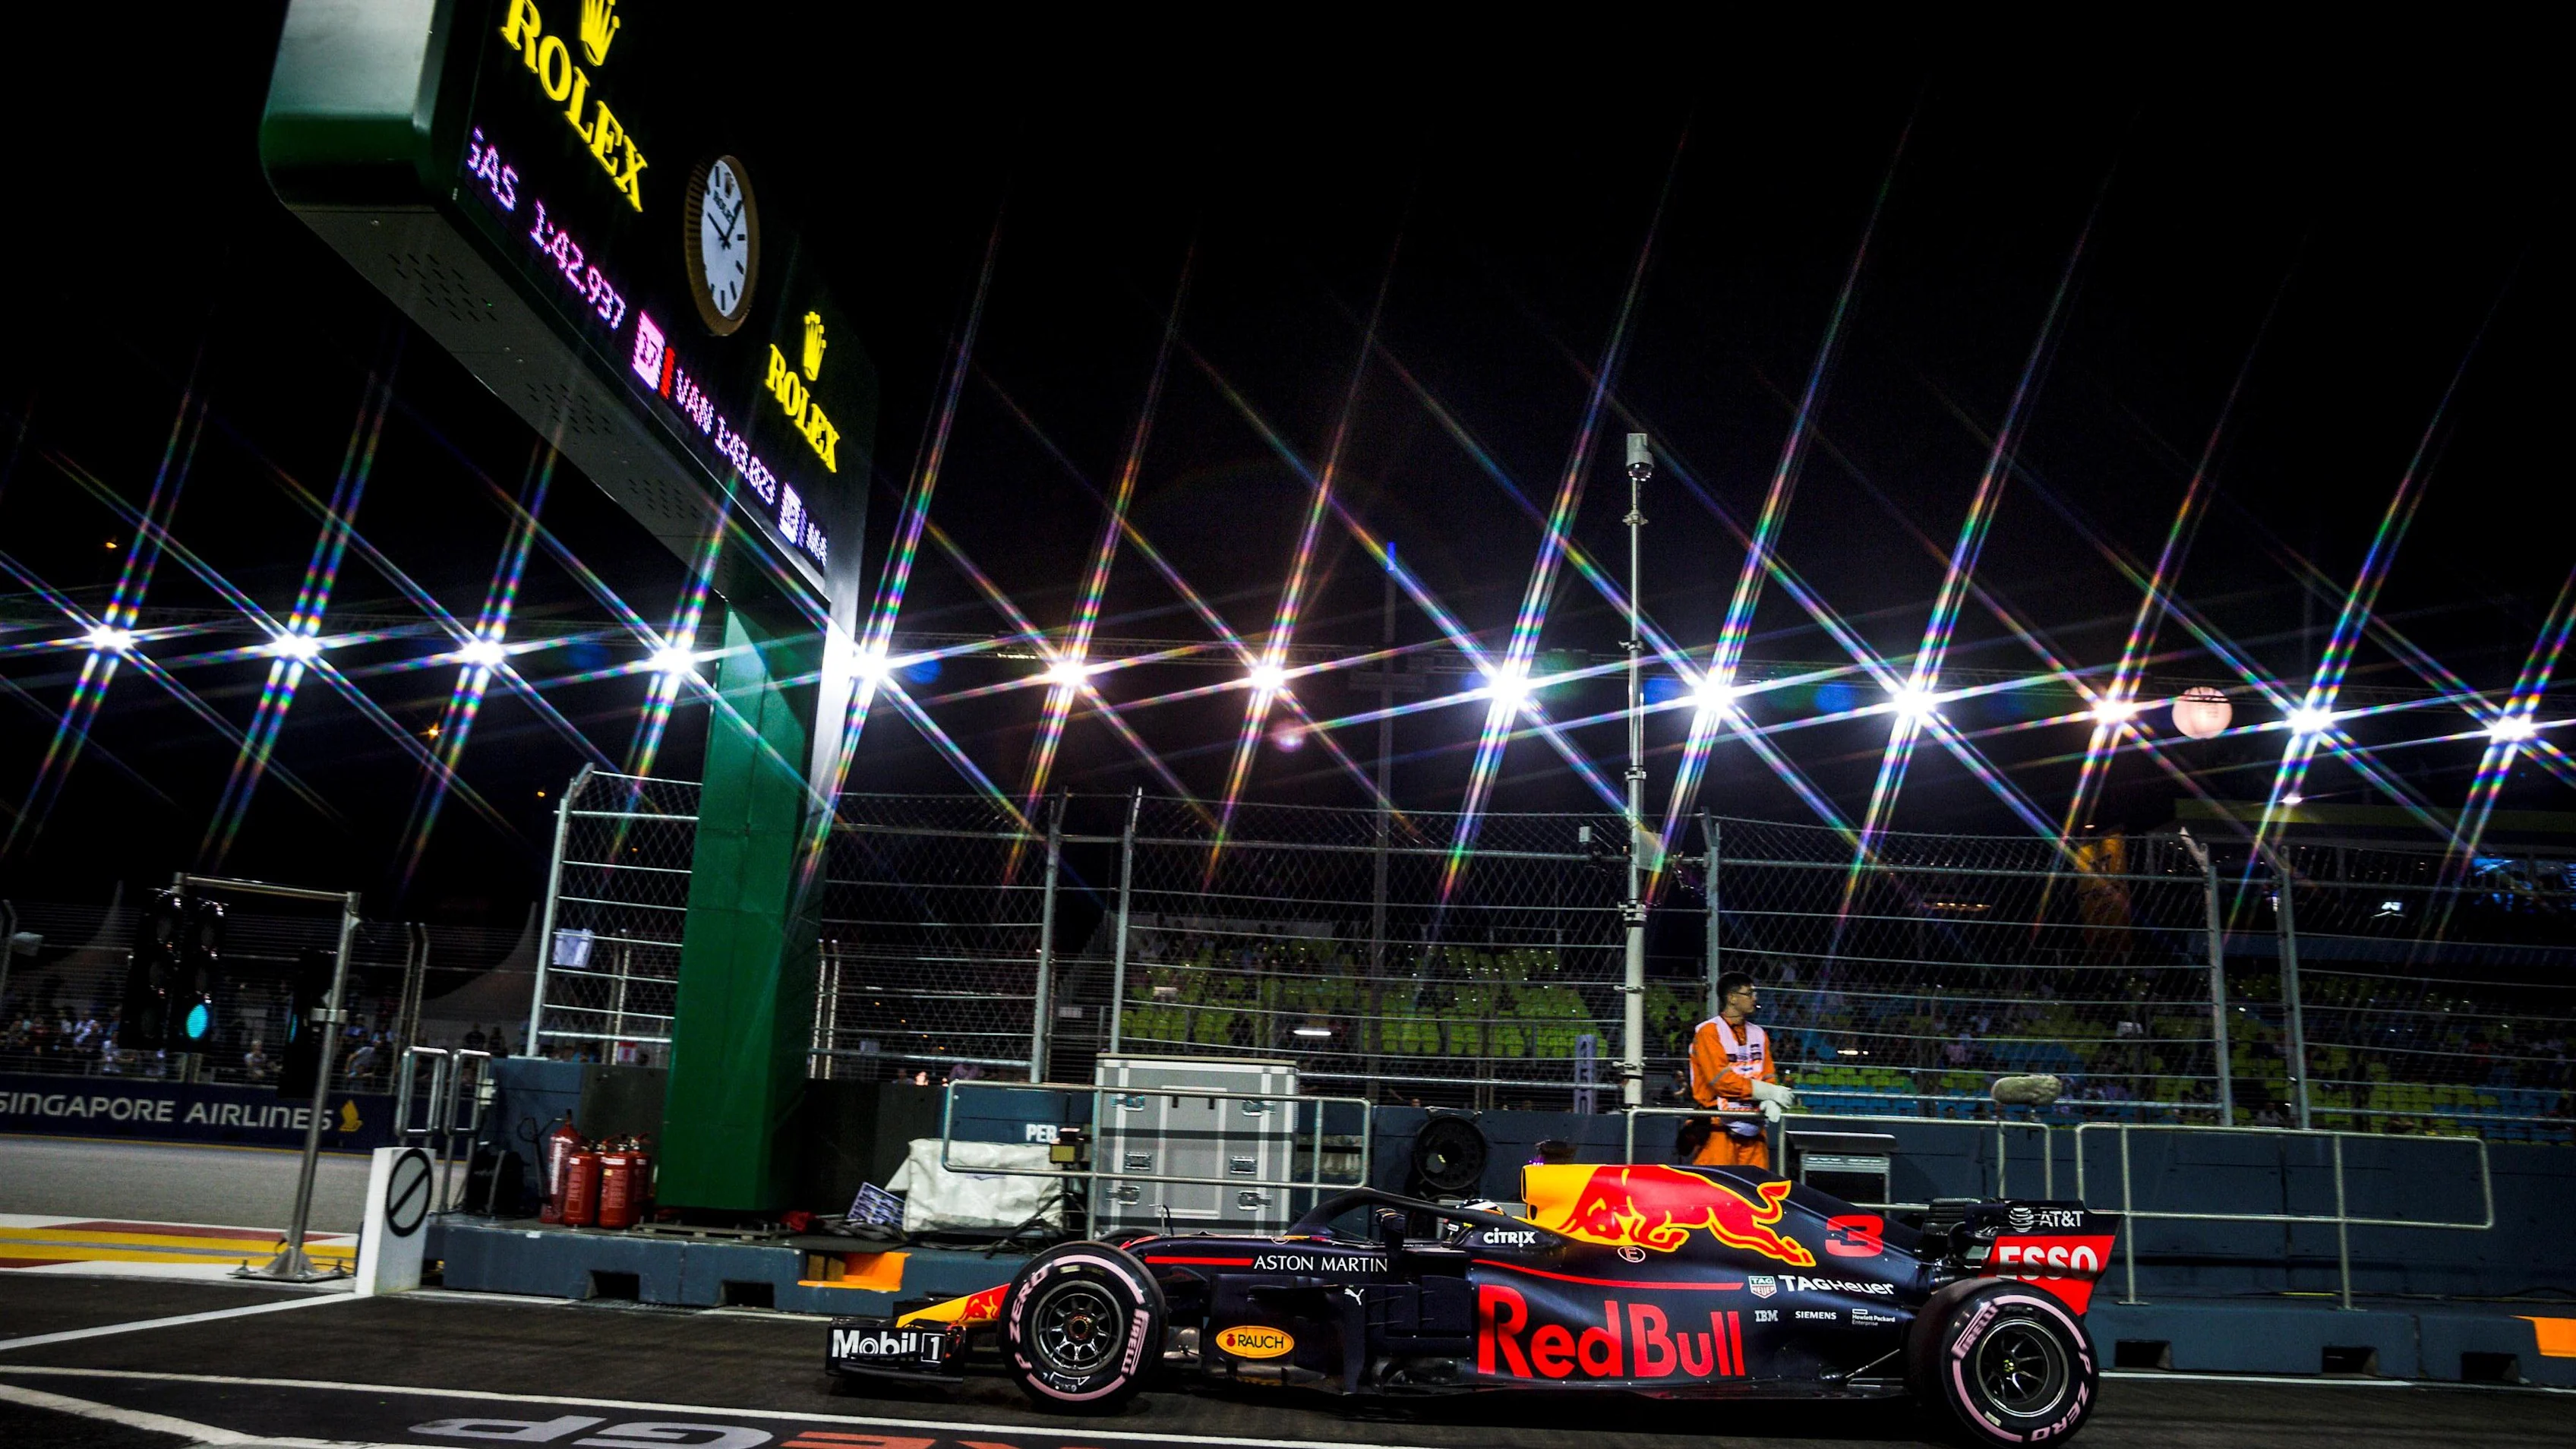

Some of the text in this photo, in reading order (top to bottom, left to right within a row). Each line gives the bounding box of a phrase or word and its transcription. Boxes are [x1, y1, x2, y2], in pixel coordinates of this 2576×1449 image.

[499, 0, 648, 213] ROLEX
[676, 367, 715, 435] VAN
[766, 343, 841, 473] ROLEX
[184, 1101, 333, 1130] AIRLINES
[1825, 1215, 1883, 1257] 3
[2039, 1211, 2084, 1227] AT&T
[1254, 1255, 1388, 1272] ASTON MARTIN
[1996, 1245, 2098, 1280] ESSO
[1009, 1264, 1051, 1369] P ZERO
[1754, 1310, 1836, 1322] IBM SIEMENS
[1951, 1301, 1999, 1359] PIRELLI
[832, 1329, 940, 1360] Mobil 1
[1121, 1309, 1151, 1375] PIRELLI
[1238, 1334, 1283, 1350] RAUCH
[2030, 1352, 2092, 1442] P ZERO
